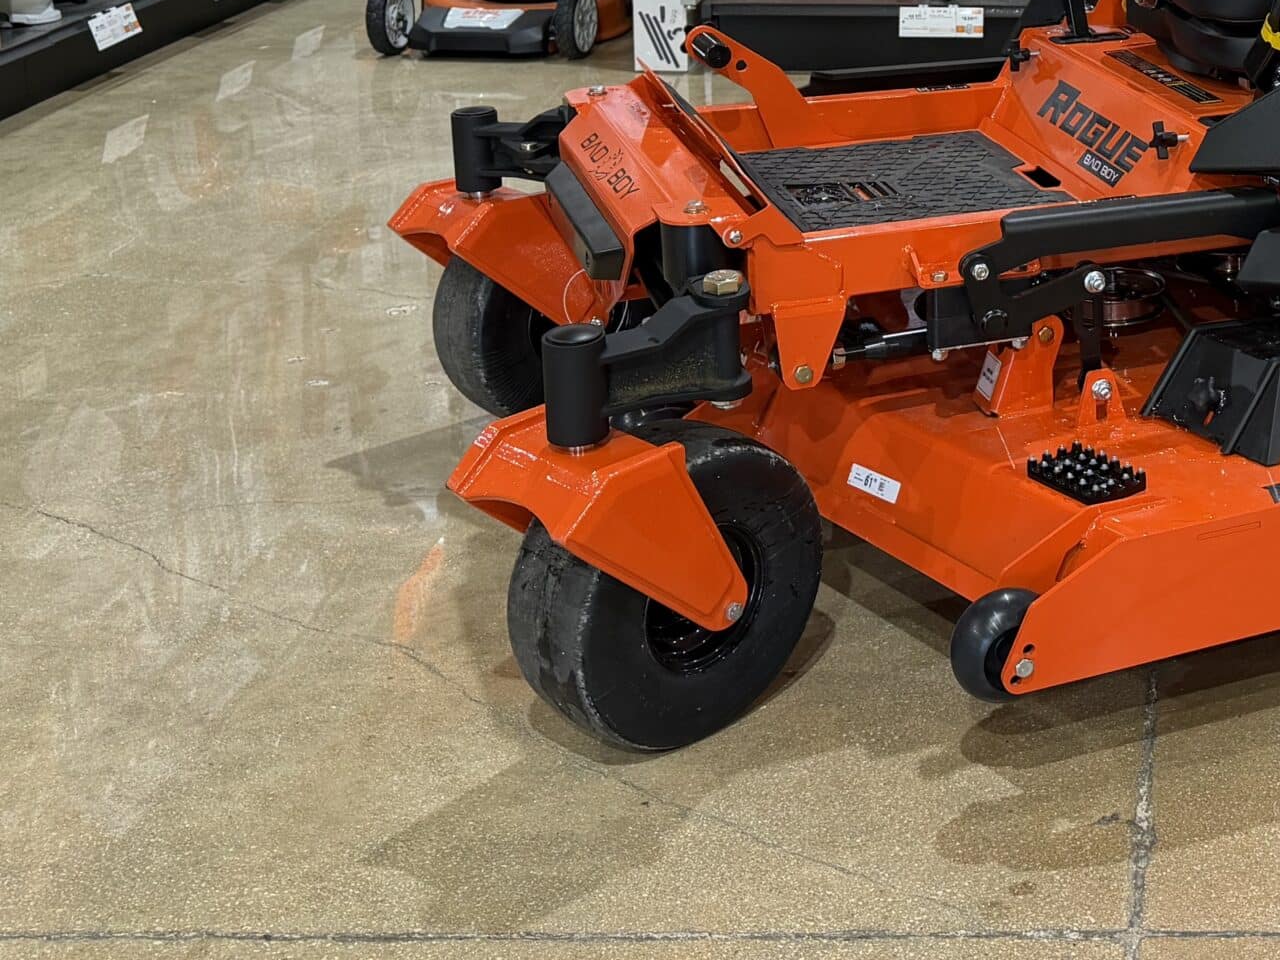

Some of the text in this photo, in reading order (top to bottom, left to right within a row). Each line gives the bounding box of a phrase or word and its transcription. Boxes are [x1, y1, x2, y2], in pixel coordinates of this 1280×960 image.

[1037, 79, 1150, 173] ROGUE
[580, 132, 609, 163] BAD
[607, 168, 640, 199] BOY
[1083, 153, 1119, 183] BAD BOY
